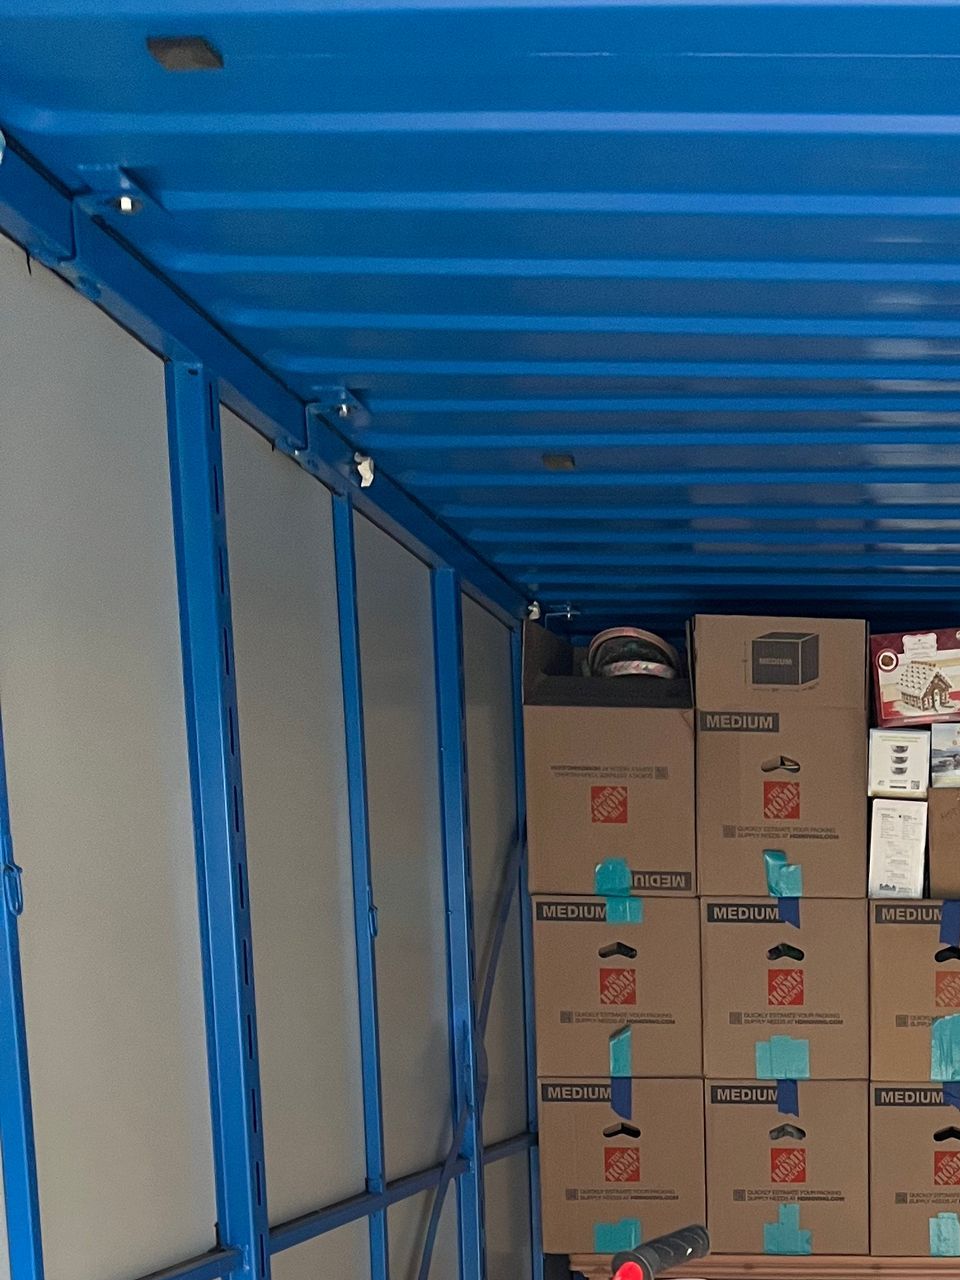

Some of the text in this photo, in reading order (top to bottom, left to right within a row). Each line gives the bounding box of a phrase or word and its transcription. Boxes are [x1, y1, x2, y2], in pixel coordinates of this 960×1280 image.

[706, 715, 773, 729] MEDIUM
[634, 874, 685, 887] MEDIU
[542, 906, 606, 918] MEDIUM
[714, 907, 779, 920] MEDIUM
[548, 1087, 611, 1098] MEDIUM
[881, 1091, 944, 1104] MEDIUM
